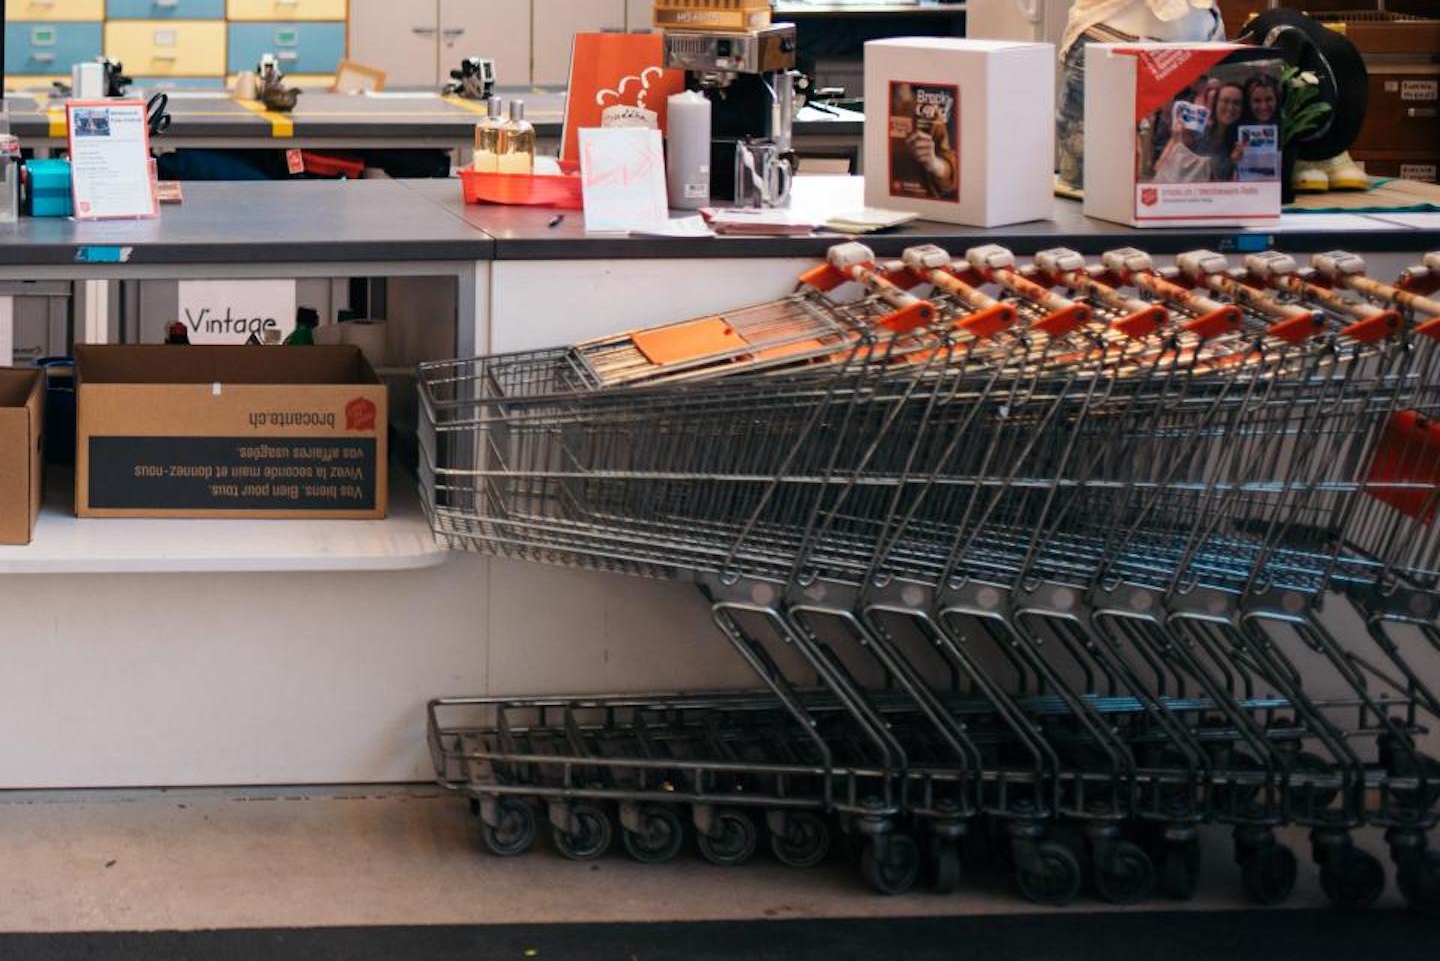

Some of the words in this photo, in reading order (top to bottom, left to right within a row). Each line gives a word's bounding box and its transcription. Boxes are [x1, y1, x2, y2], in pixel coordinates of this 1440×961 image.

[185, 307, 276, 336] Vintage
[249, 411, 335, 429] brocante.ch
[293, 446, 339, 461] affaires
[343, 446, 364, 458] vos
[134, 465, 212, 480] donnez-nous
[215, 465, 228, 478] et
[231, 466, 261, 479] main
[263, 466, 313, 479] seconde
[316, 466, 327, 479] la
[330, 466, 363, 479] Vivez
[240, 484, 271, 497] pour
[272, 486, 298, 499] Bien
[339, 486, 363, 499] Vos
